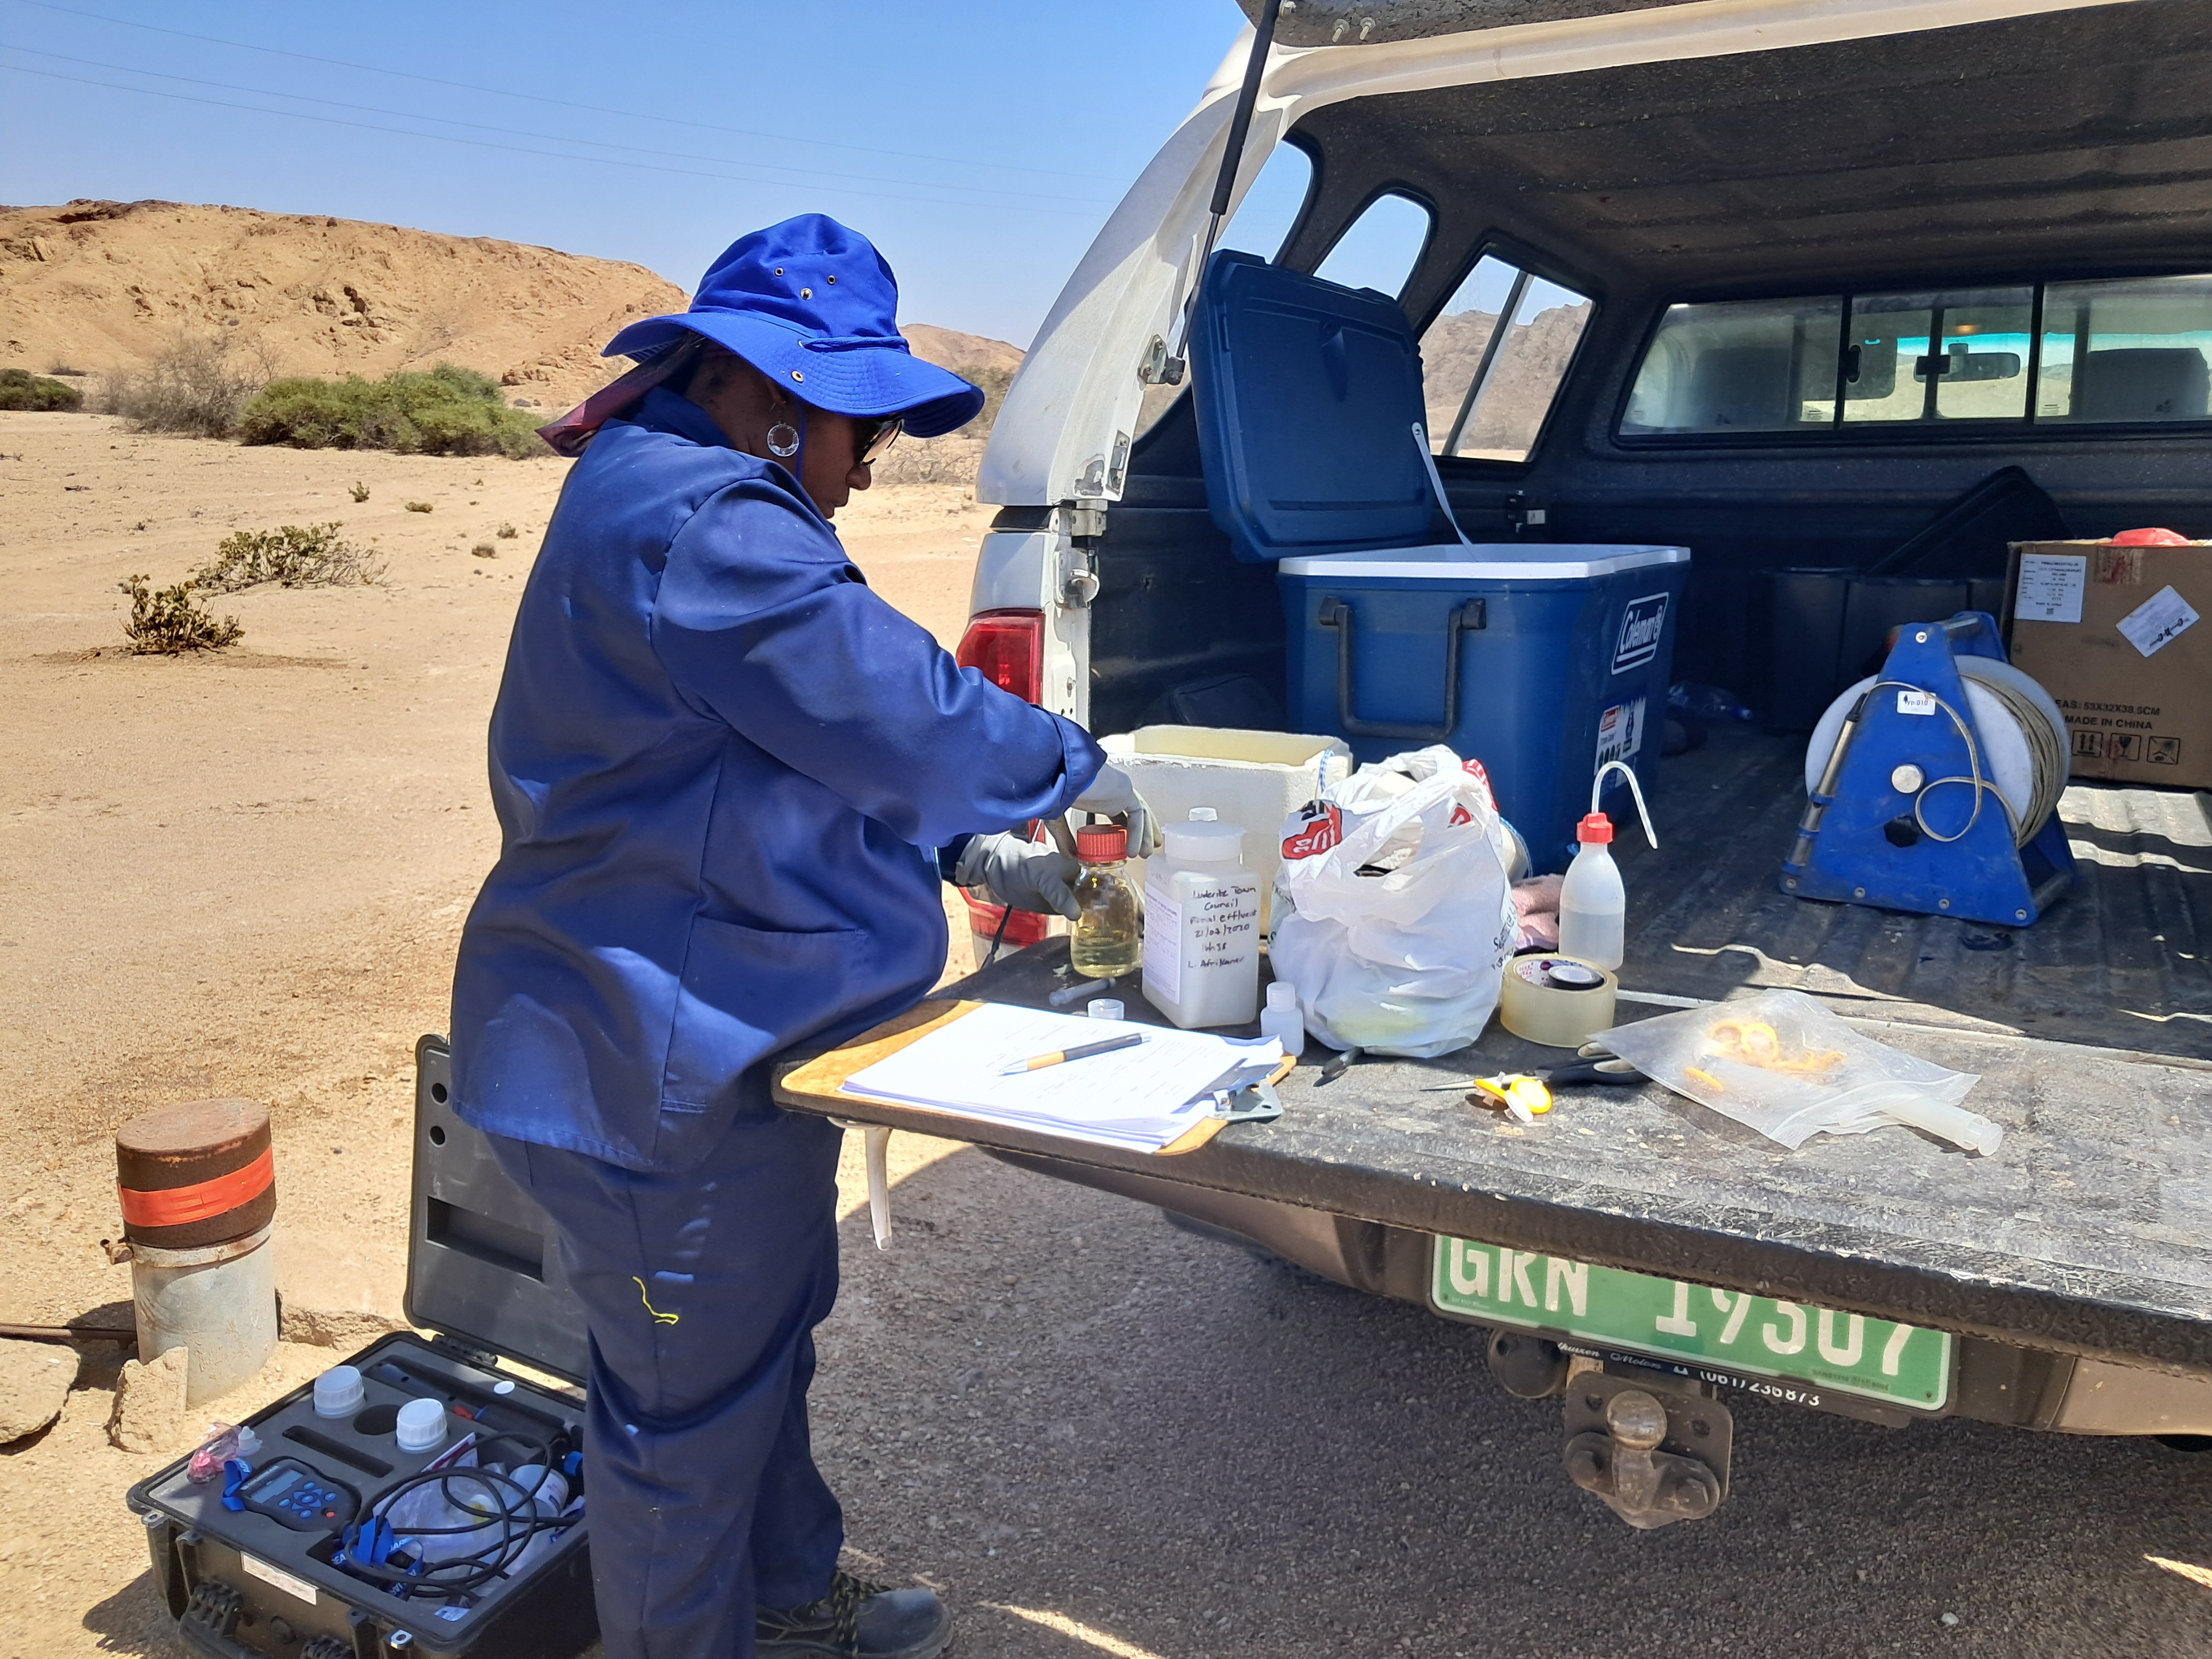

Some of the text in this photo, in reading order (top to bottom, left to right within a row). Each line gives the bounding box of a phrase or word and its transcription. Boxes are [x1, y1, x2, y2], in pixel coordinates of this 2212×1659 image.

[1620, 608, 1656, 654] Coleman
[2055, 699, 2080, 709] EAS:
[2065, 715, 2152, 729] MADE IN CHINA
[1231, 886, 1256, 894] Town
[1204, 898, 1238, 911] Council
[1190, 914, 1215, 924] Final
[1450, 1237, 1589, 1317] GRN
[1610, 1352, 1662, 1369] Motors
